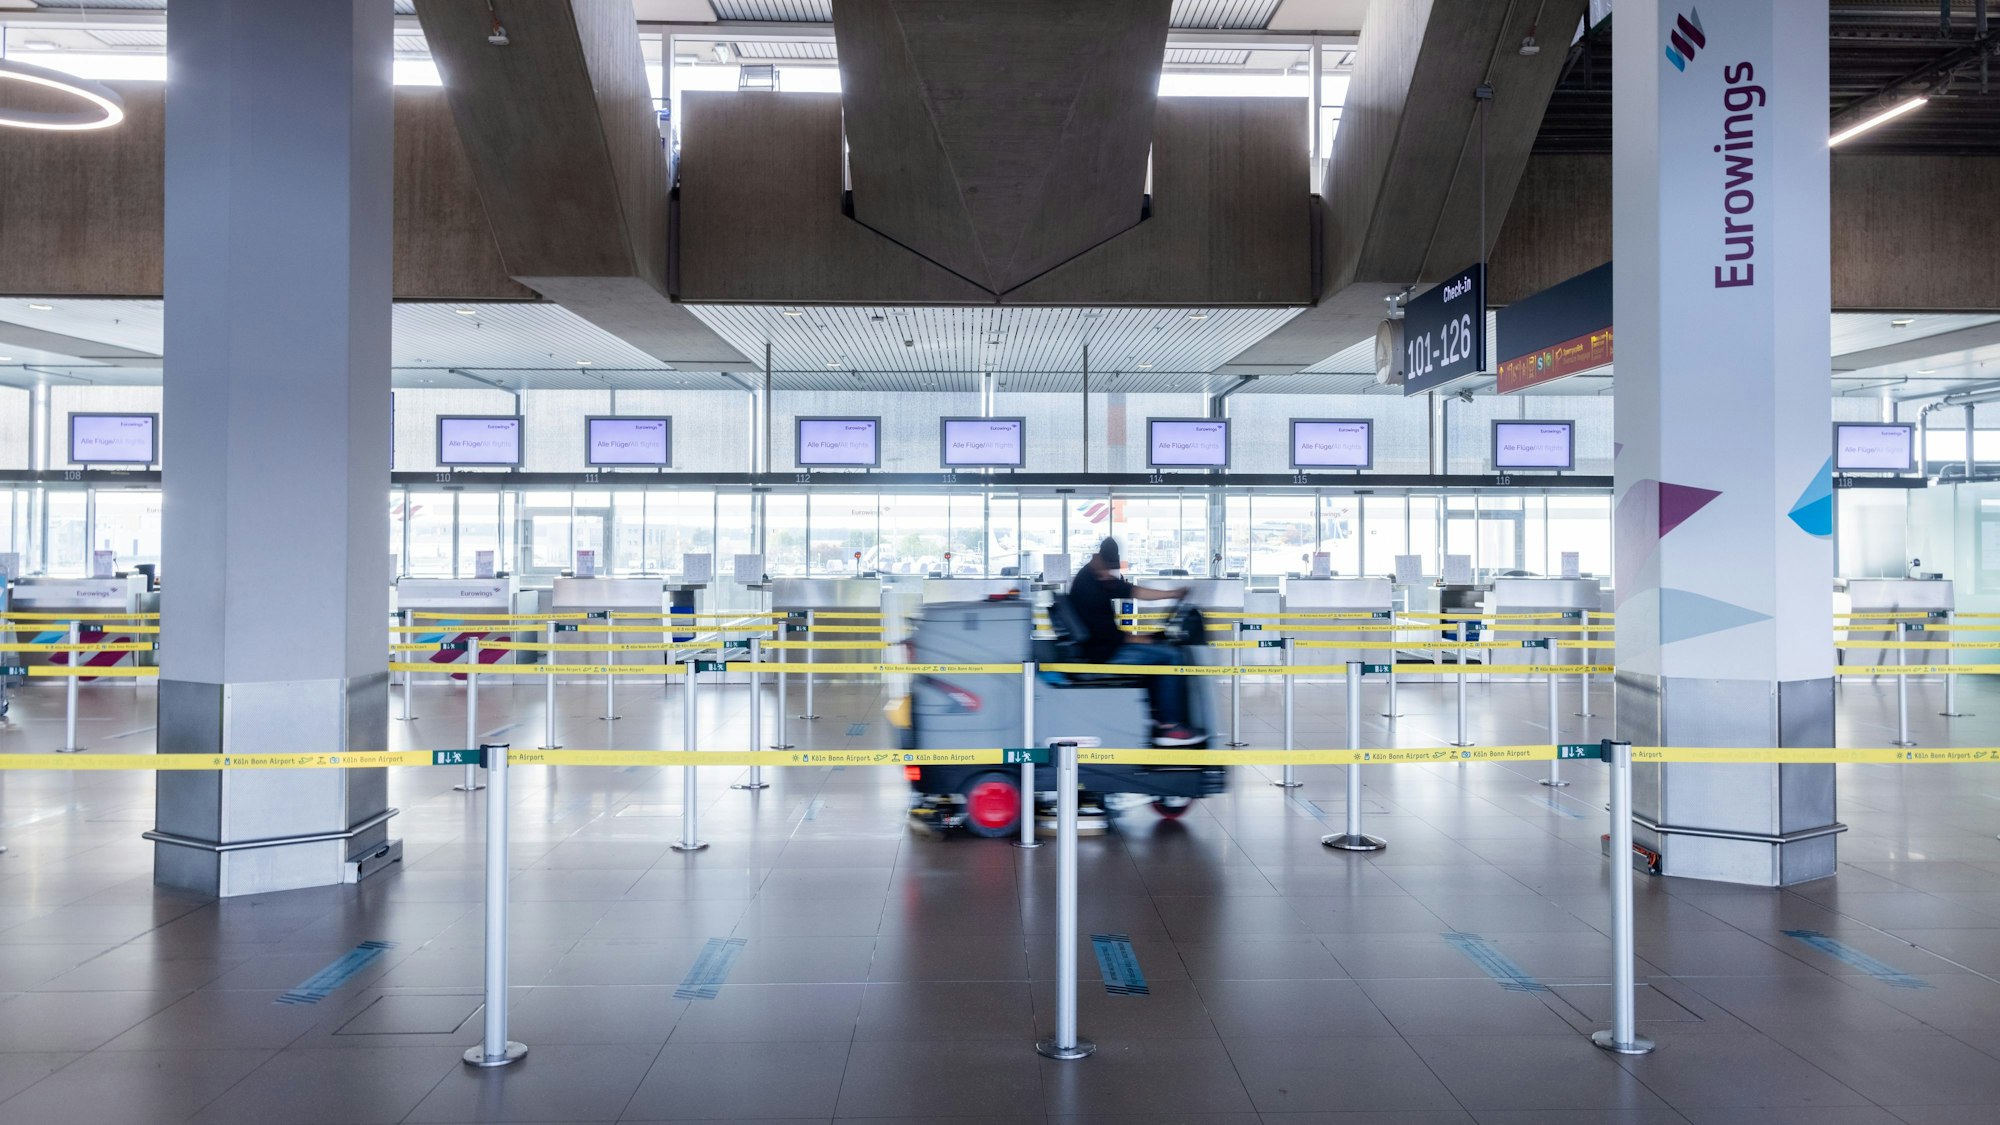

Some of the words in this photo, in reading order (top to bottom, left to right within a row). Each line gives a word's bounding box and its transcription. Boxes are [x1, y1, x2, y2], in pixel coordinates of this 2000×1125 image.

[1714, 61, 1766, 288] Eurowings
[1443, 275, 1472, 303] Check-in
[1408, 313, 1471, 380] 101-126
[64, 472, 81, 480] 108
[436, 474, 450, 482] 110
[585, 474, 599, 482] 111
[796, 474, 810, 483] 112
[942, 474, 956, 483] 113
[1150, 475, 1163, 483] 114
[1293, 475, 1307, 484] 115
[1496, 476, 1510, 485] 116
[1838, 478, 1853, 487] 118
